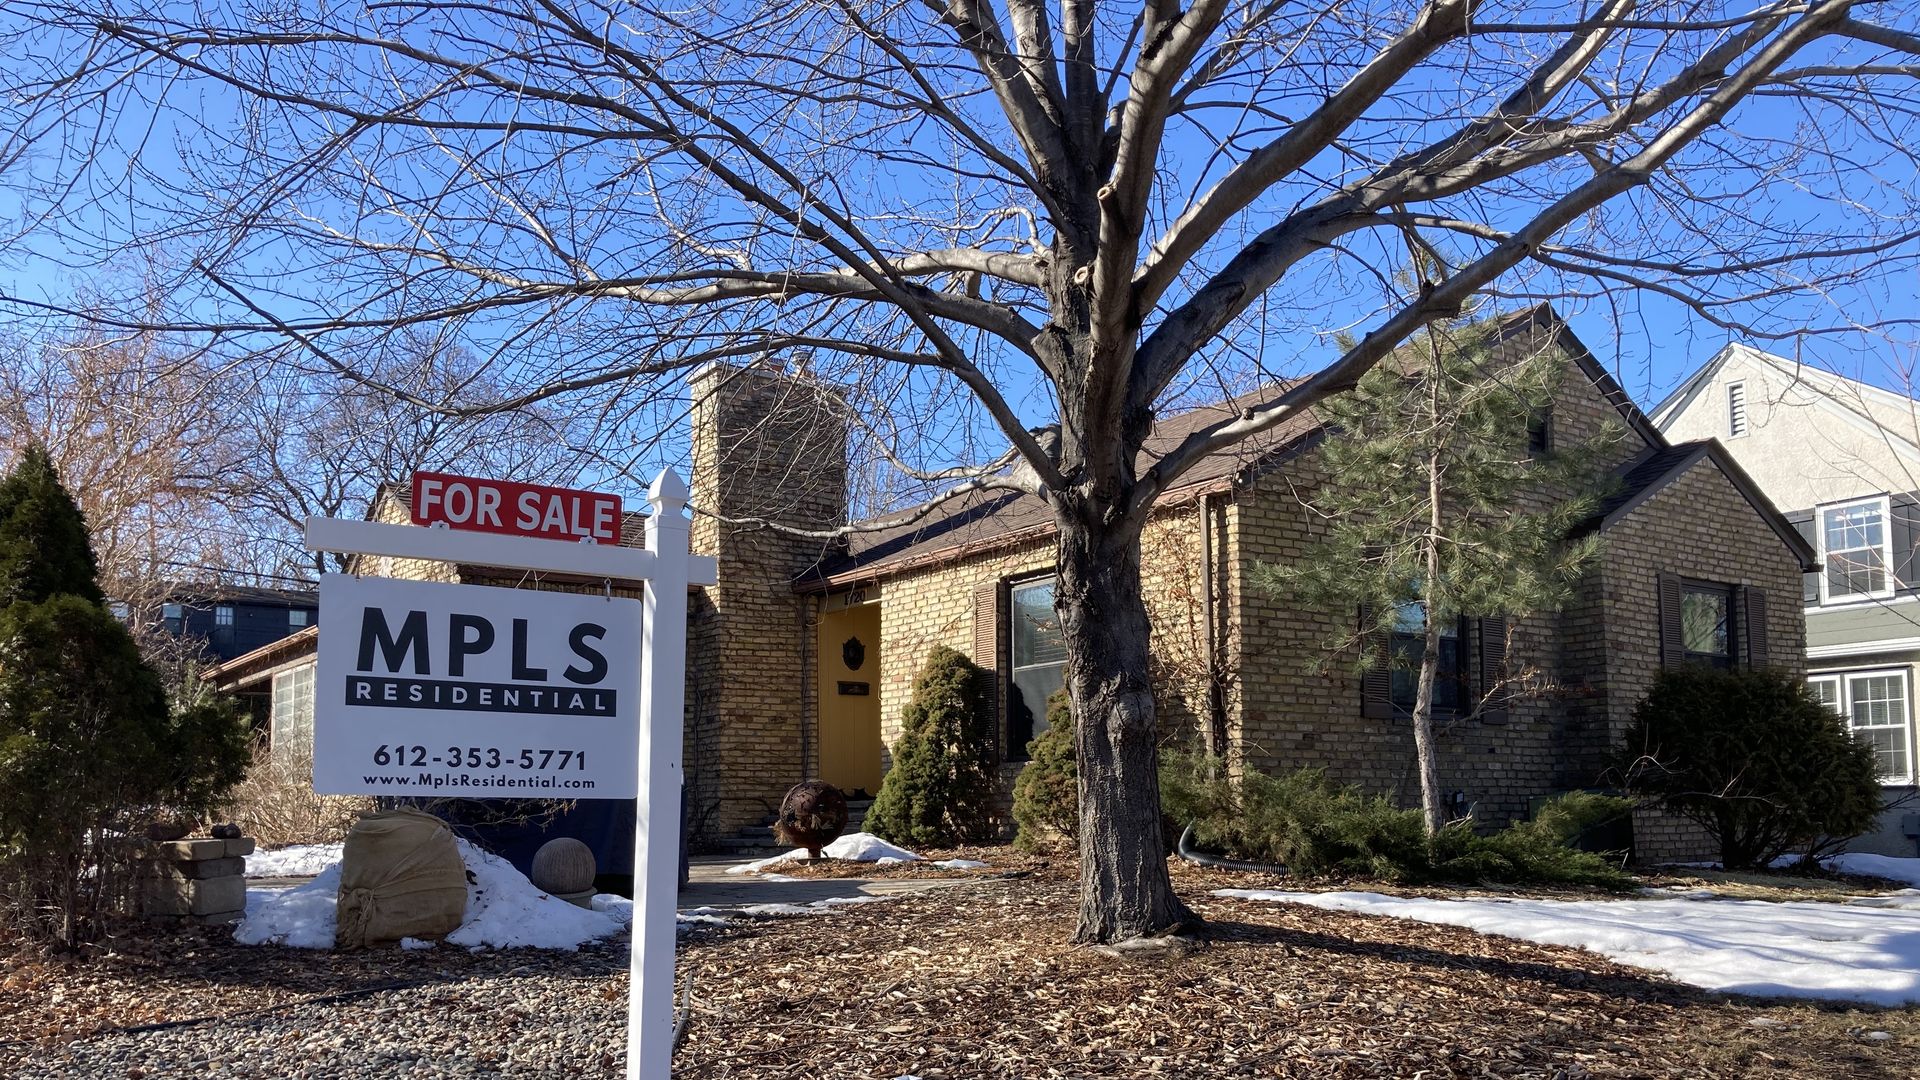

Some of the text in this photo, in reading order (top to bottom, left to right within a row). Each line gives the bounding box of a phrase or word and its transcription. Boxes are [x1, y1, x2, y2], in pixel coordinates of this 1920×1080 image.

[419, 480, 615, 539] FOR SALE
[357, 607, 608, 684] MPLS
[356, 682, 605, 710] RESIDENTIAL
[373, 745, 585, 770] 612-353-5771
[363, 773, 595, 789] www.MplsResidential.com
